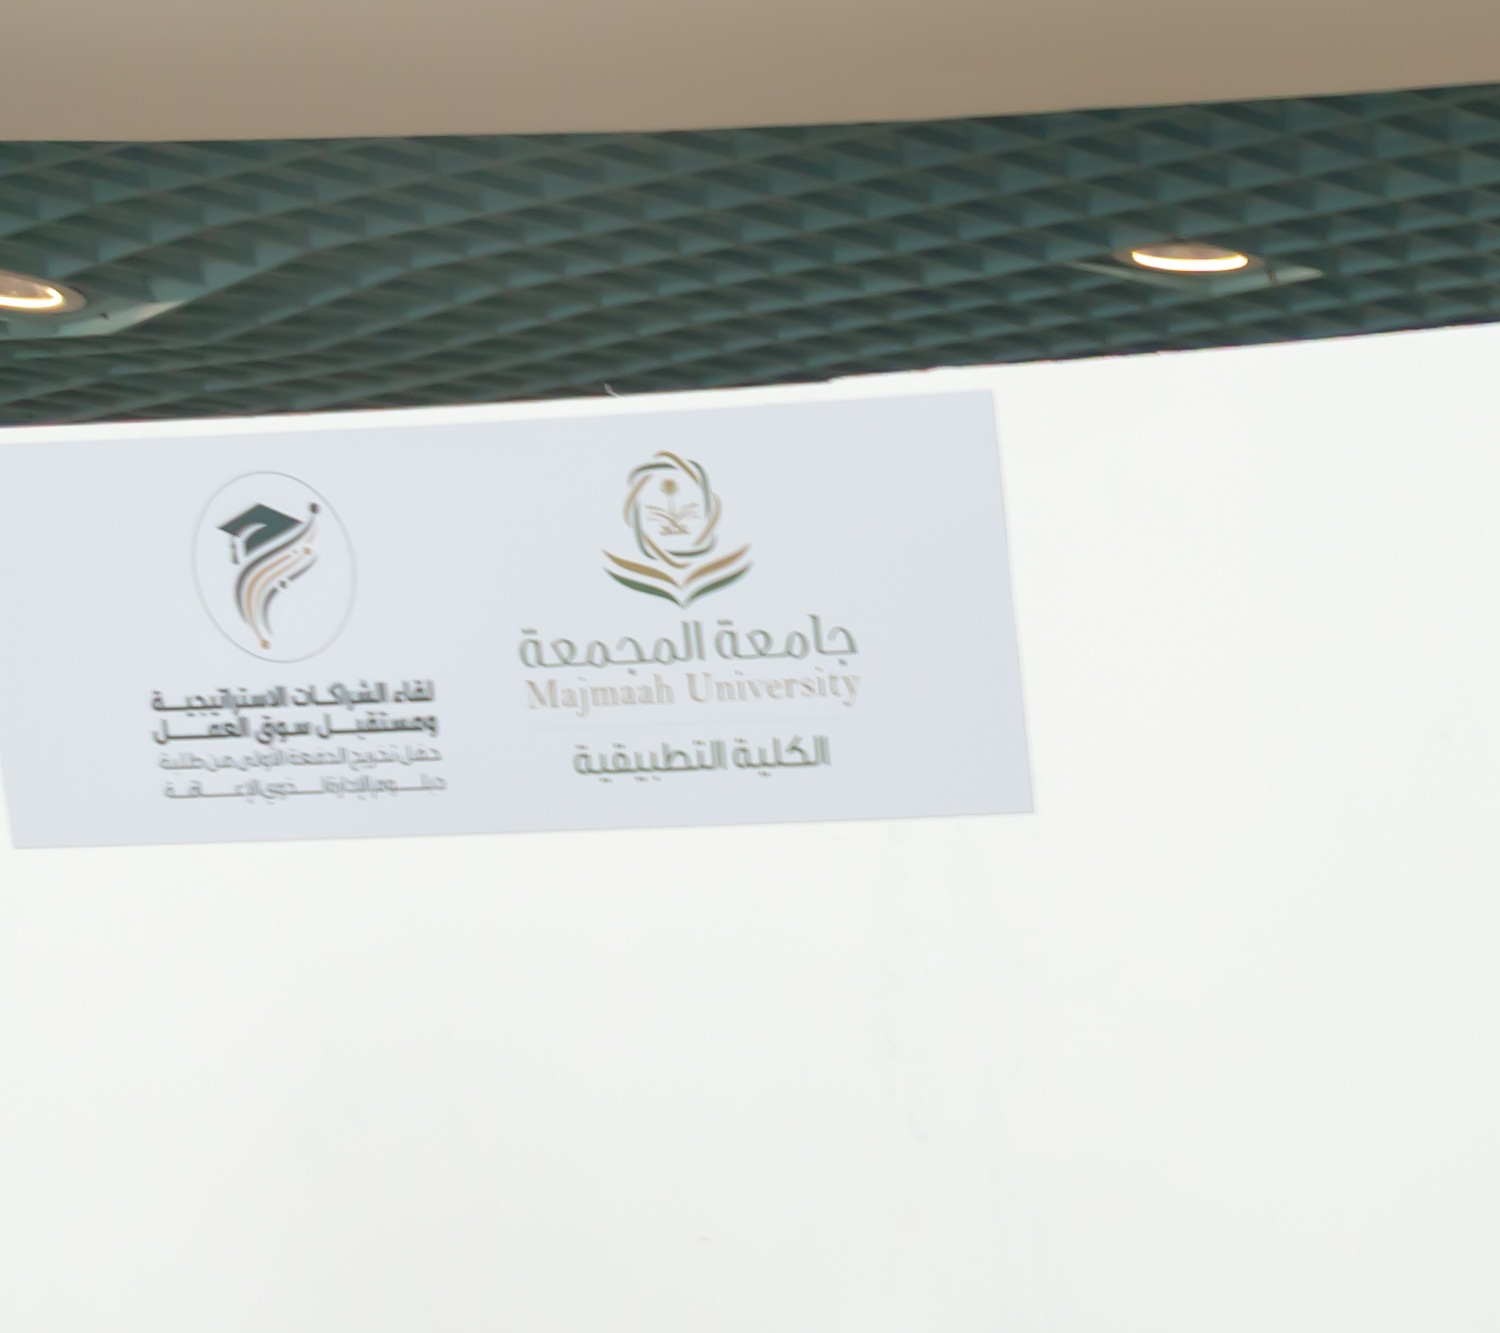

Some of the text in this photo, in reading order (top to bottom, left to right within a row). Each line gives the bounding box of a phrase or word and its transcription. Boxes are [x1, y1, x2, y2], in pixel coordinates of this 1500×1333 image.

[518, 613, 859, 676] جامعة المجمعة
[393, 679, 435, 703] لقاء
[524, 665, 860, 718] Majmaah University
[255, 714, 311, 744] سوق
[572, 735, 831, 783] الكلية التطبيقية
